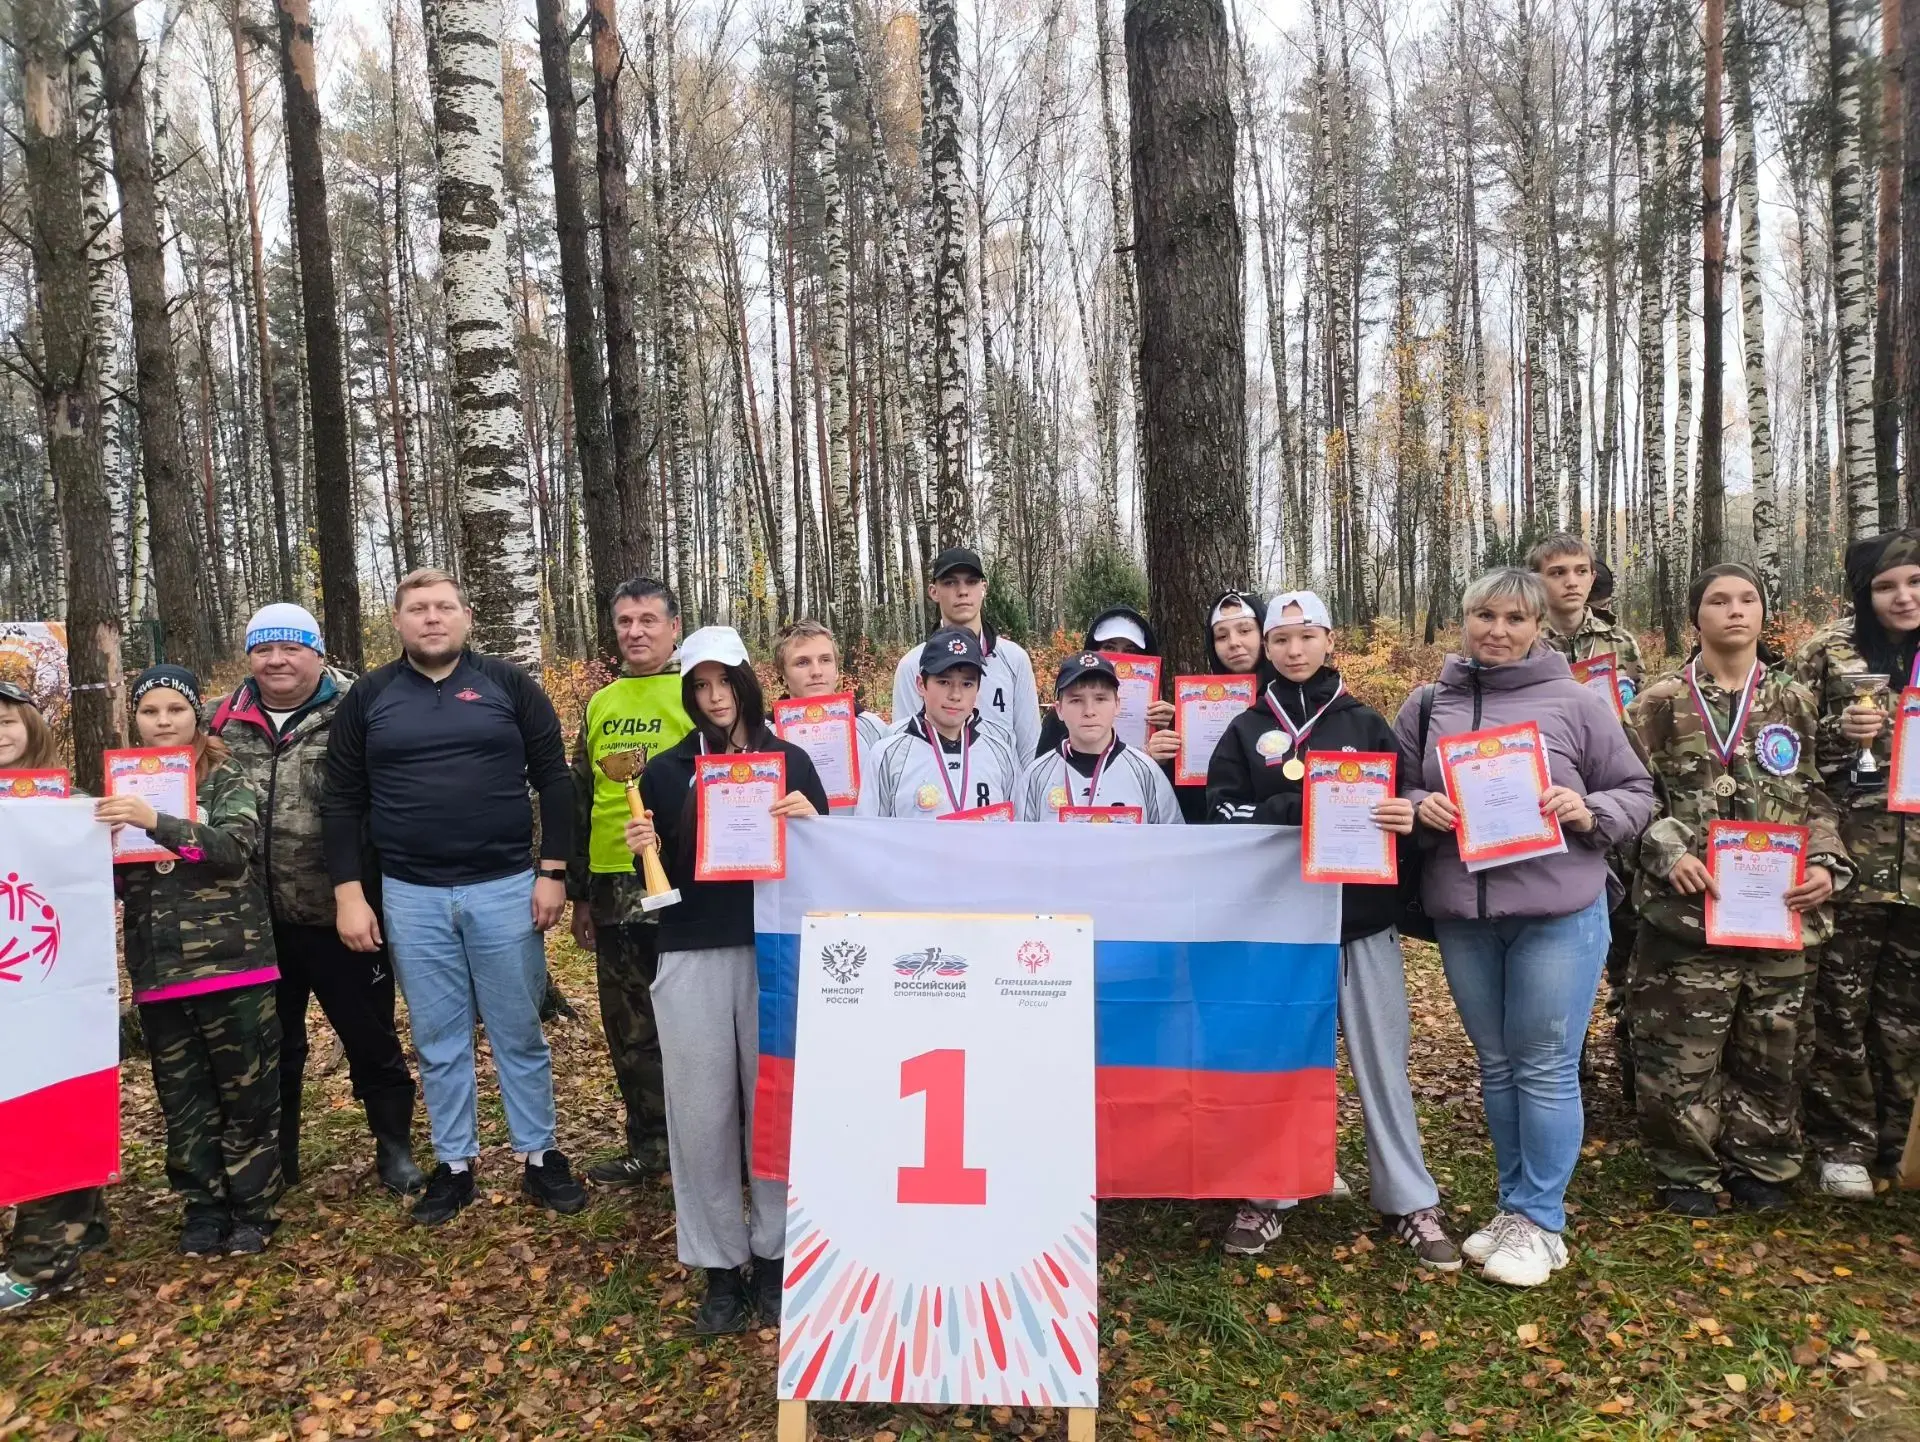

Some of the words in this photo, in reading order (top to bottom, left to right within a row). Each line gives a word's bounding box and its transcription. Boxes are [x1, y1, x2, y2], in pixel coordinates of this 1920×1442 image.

[992, 687, 1006, 713] 4
[602, 718, 662, 736] СУДЬЯ
[976, 782, 990, 808] 8
[1735, 863, 1780, 872] ГРАМОТА
[894, 980, 966, 990] РОССИЙСКИЙ
[995, 977, 1072, 986] Специальная
[1000, 987, 1067, 998] Олимпиада
[1018, 998, 1048, 1007] России
[897, 1049, 986, 1205] 1
